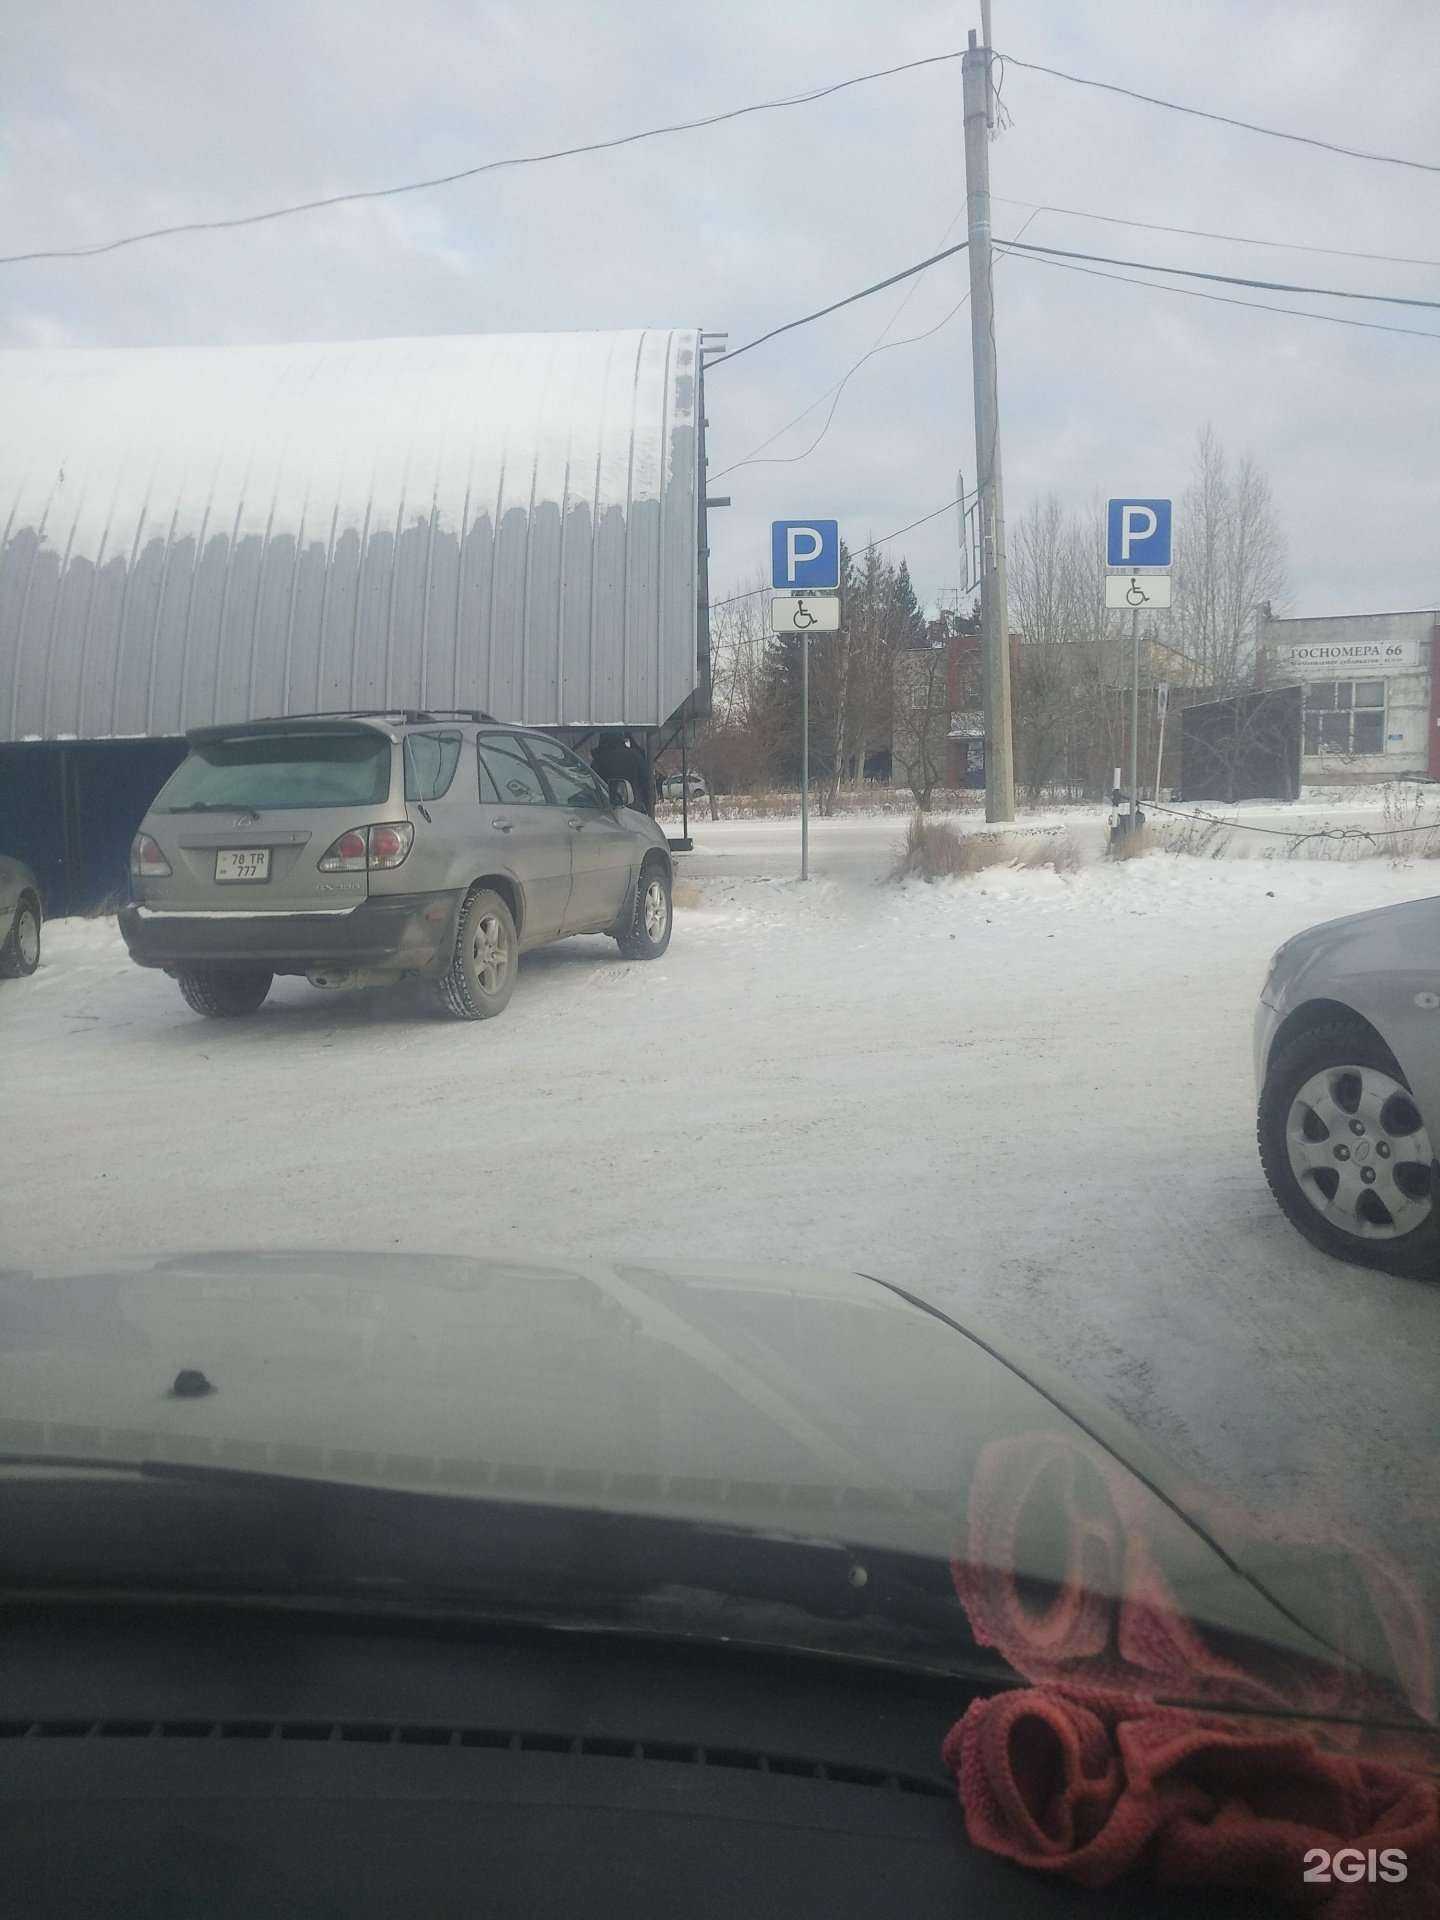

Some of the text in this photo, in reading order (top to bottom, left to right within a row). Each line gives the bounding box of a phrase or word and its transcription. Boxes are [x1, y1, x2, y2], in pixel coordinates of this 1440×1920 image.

[1121, 505, 1157, 560] P
[787, 527, 823, 582] P
[1289, 645, 1403, 659] ГОСНОМЕРА 66
[250, 853, 265, 865] TR
[237, 865, 257, 877] 777
